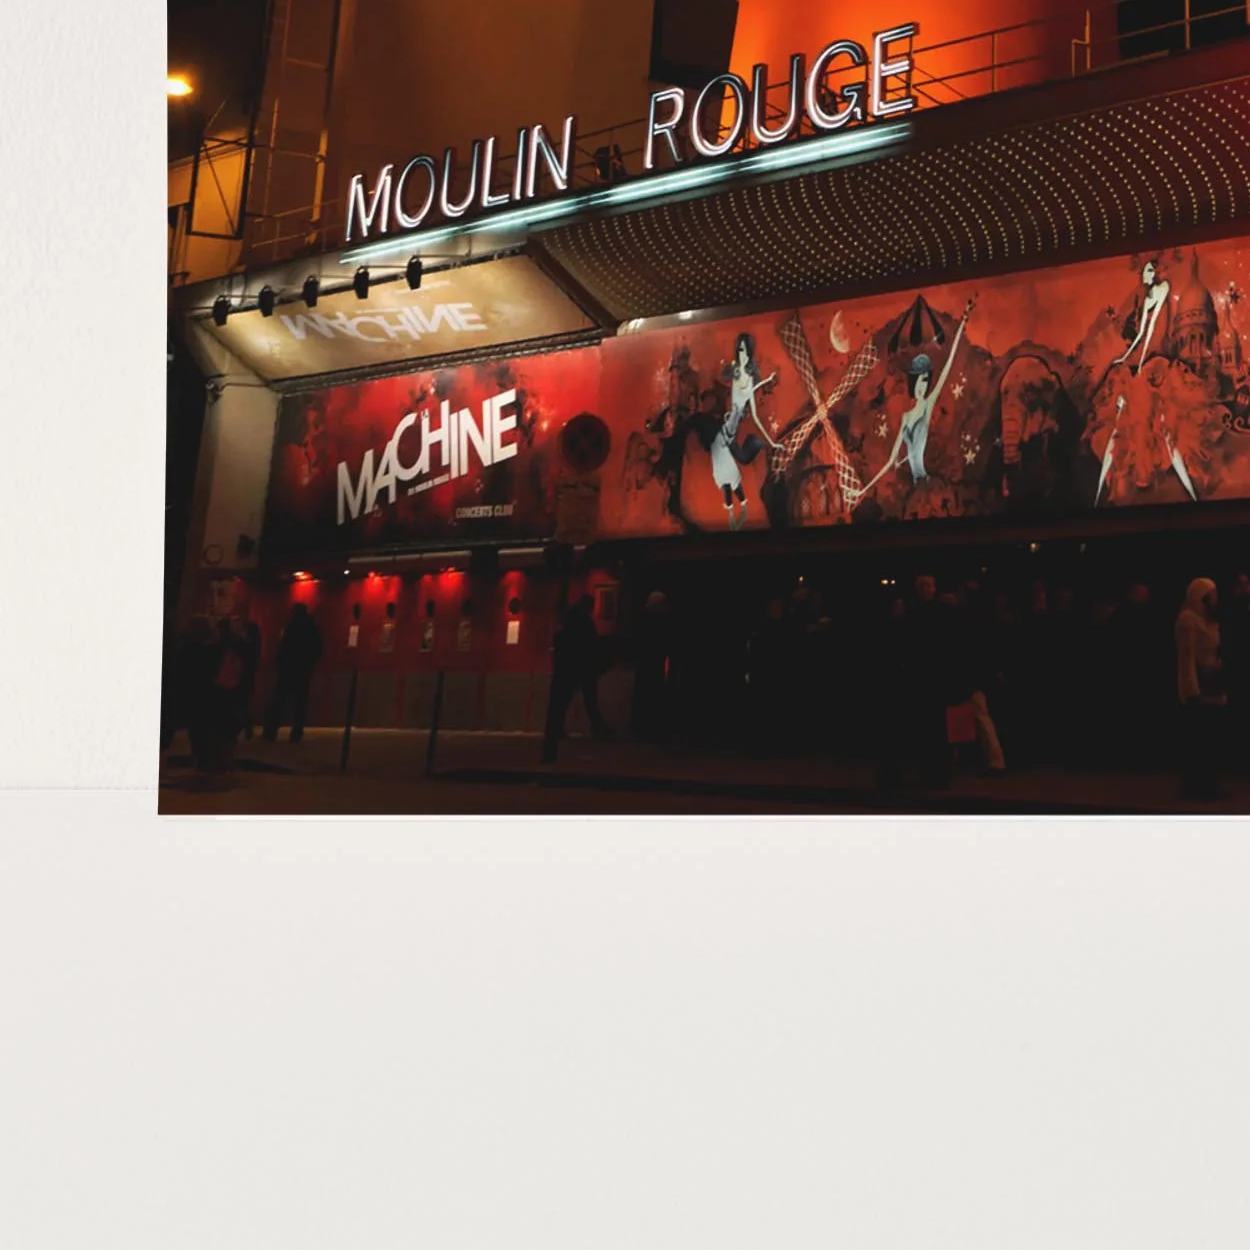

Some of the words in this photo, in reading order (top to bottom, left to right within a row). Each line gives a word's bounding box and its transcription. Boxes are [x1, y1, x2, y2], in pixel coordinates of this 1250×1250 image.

[345, 115, 574, 241] MOULIN
[642, 21, 921, 170] ROUGE
[336, 388, 518, 527] MACHINE
